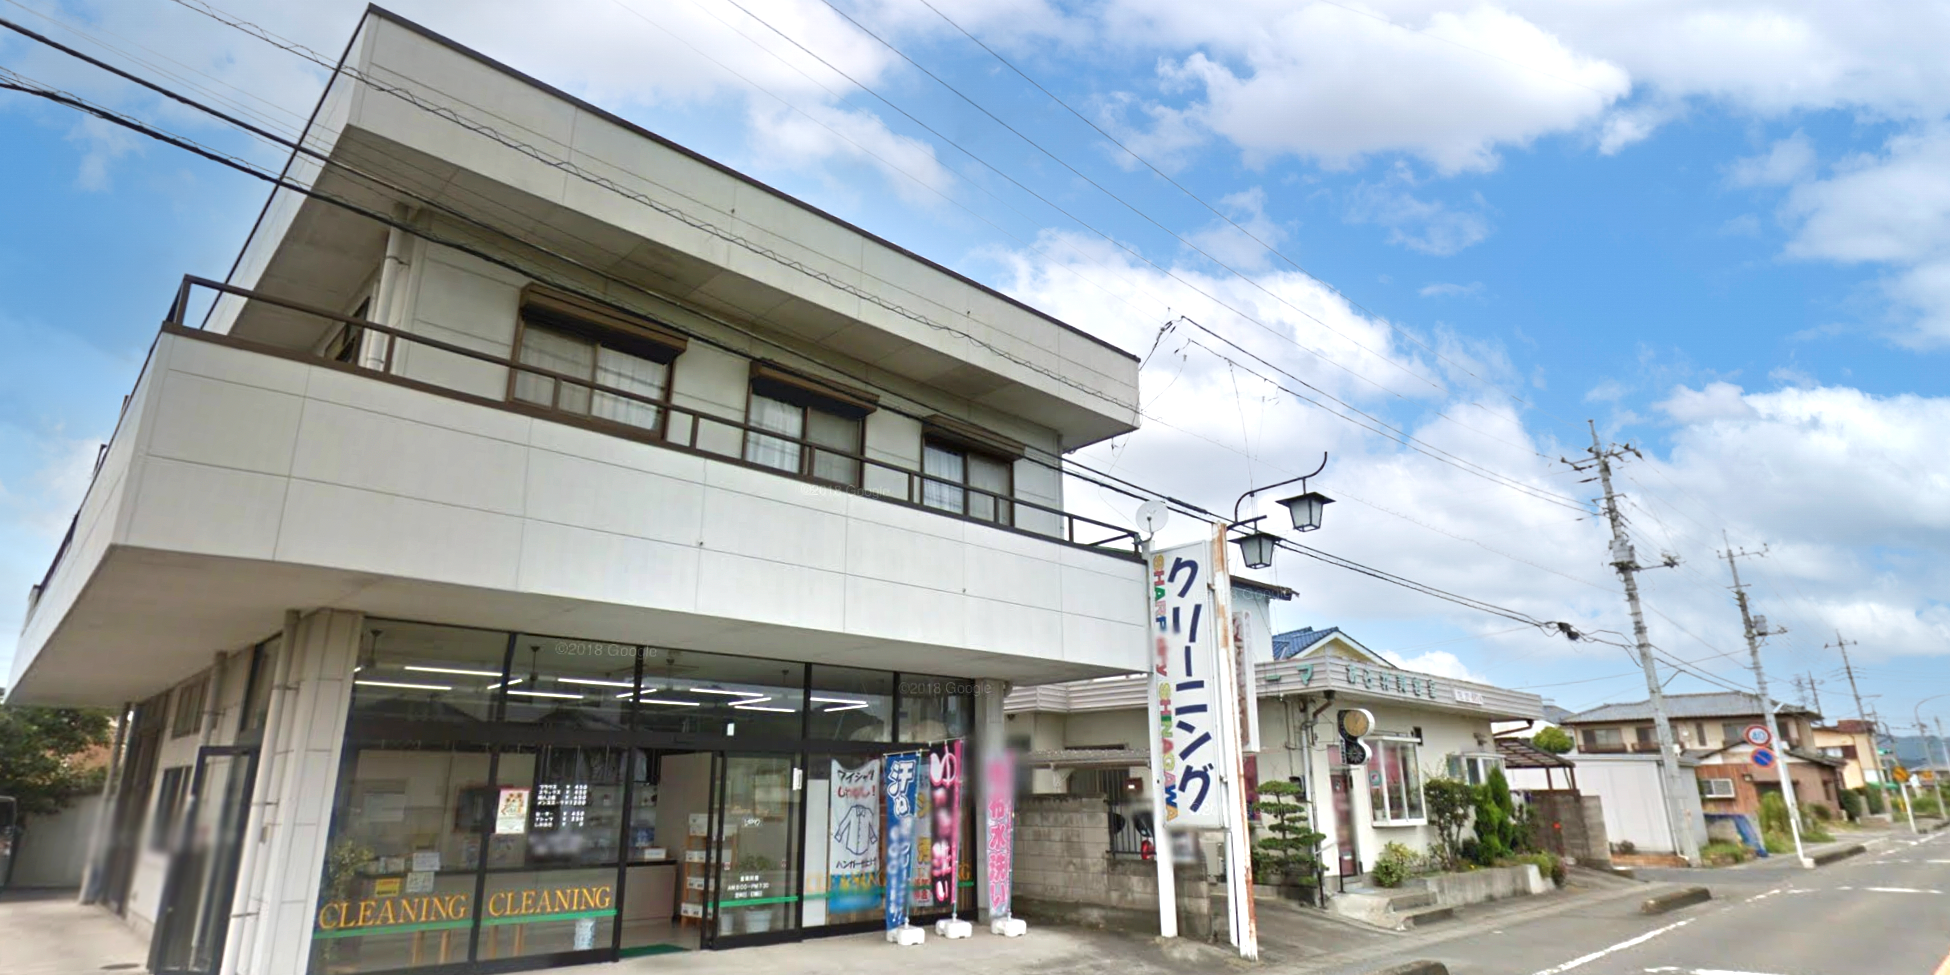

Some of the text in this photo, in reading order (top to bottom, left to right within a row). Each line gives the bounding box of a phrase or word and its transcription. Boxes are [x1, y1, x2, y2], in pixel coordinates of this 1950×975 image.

[1152, 554, 1168, 634] SHARP
[1167, 556, 1214, 813] クリーニング
[1264, 663, 1315, 687] ーマ
[1158, 682, 1179, 821] SHINAGAWA
[1751, 731, 1765, 741] 40
[318, 893, 471, 930] CLEANING
[488, 886, 612, 917] CLEANING
